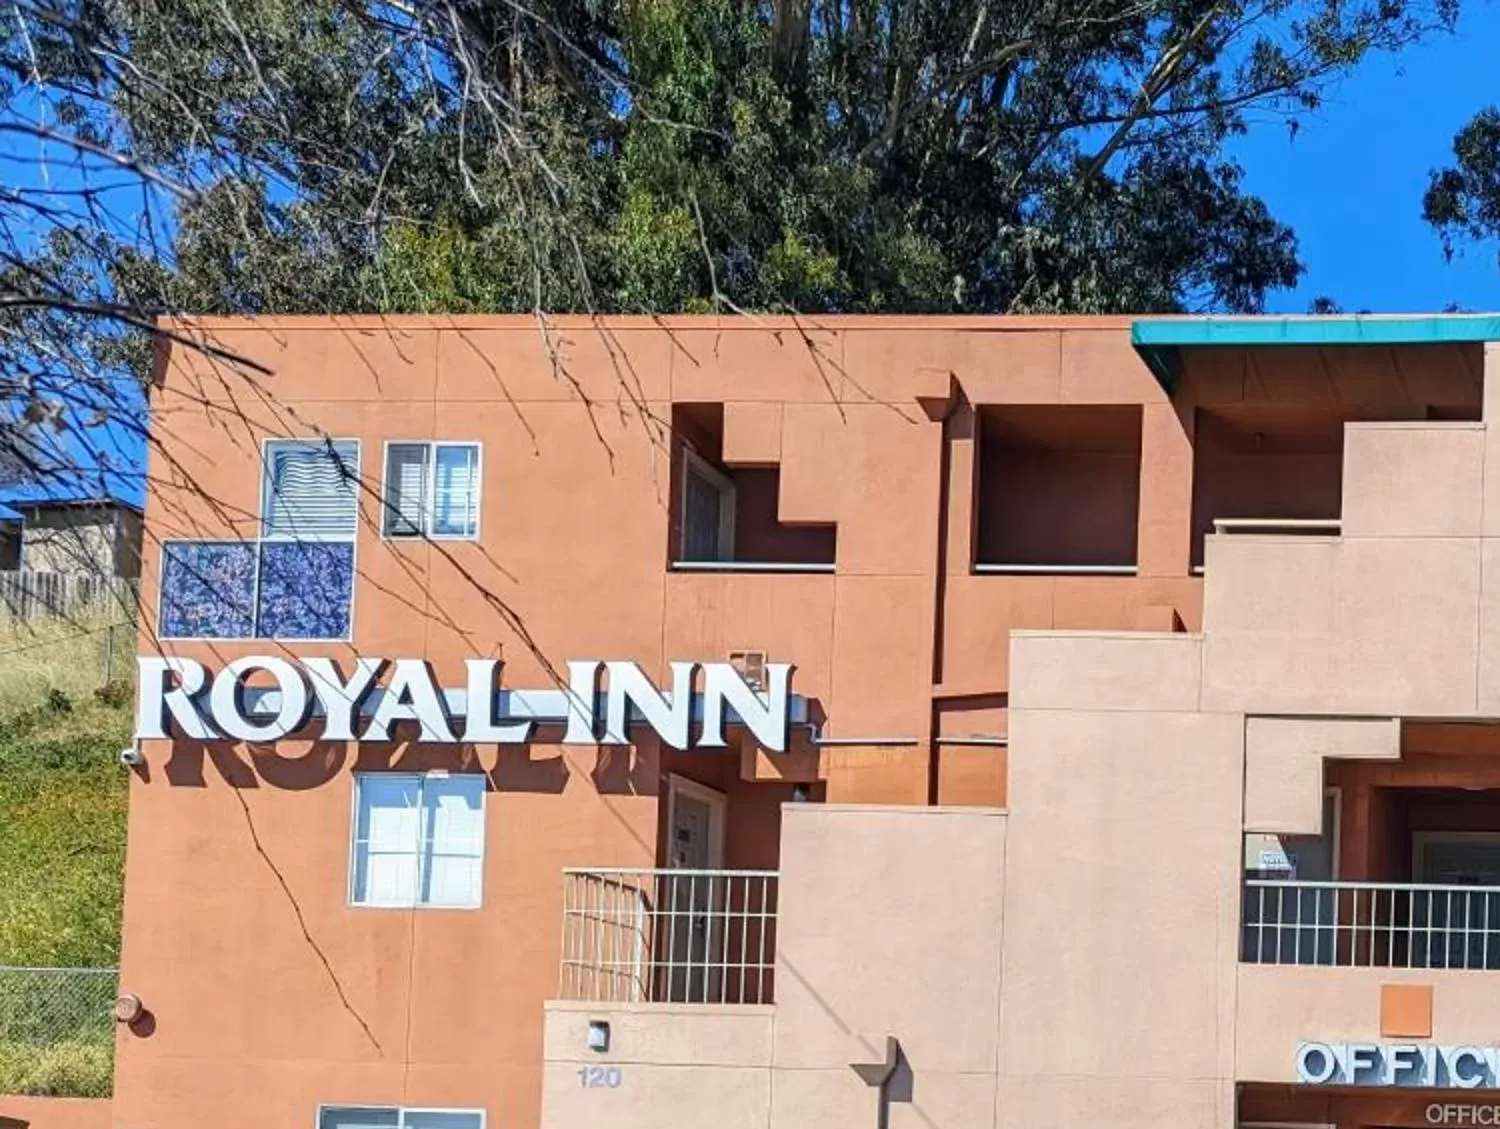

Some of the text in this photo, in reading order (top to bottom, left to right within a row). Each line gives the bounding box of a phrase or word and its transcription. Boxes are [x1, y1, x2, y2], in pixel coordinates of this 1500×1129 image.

[135, 655, 797, 752] ROYAL INN
[577, 1066, 622, 1089] 120
